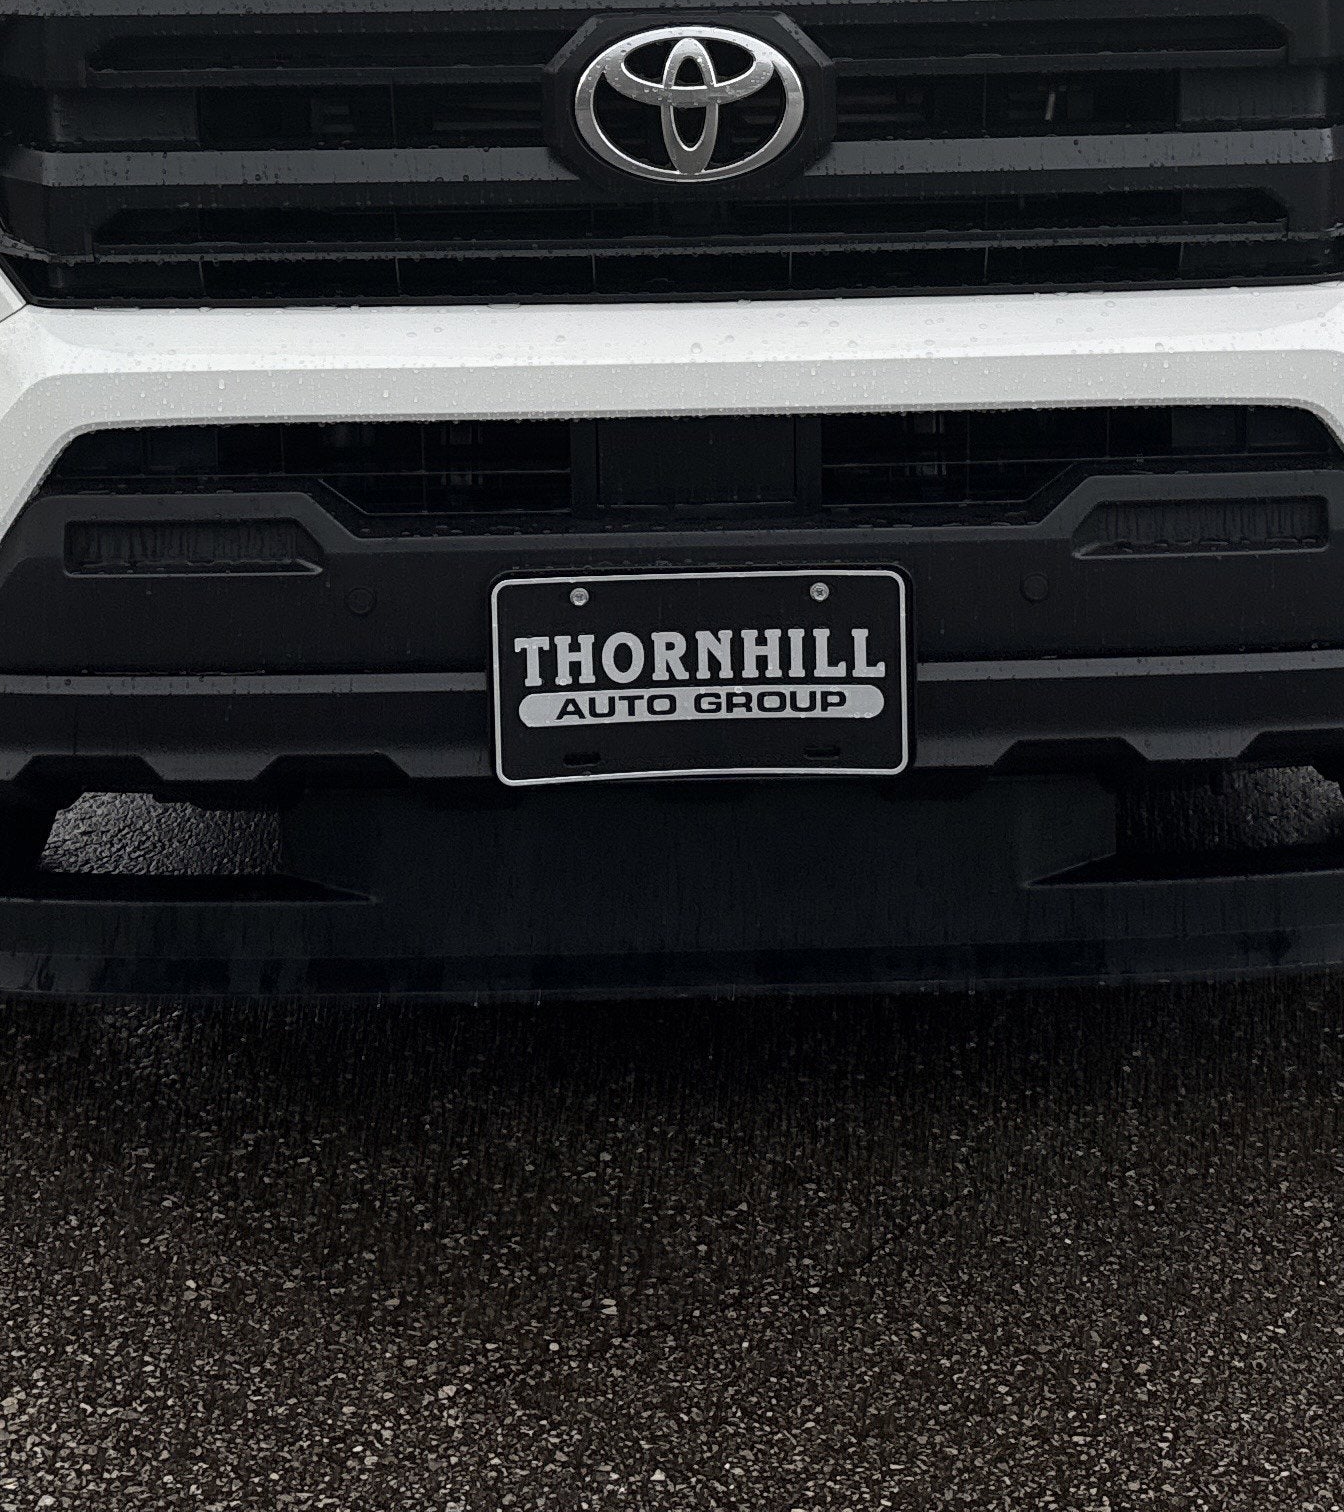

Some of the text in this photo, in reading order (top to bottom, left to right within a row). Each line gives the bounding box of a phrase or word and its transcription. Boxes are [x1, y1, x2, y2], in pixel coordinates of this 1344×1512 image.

[514, 628, 886, 687] THORNHILL
[555, 690, 847, 721] AUTO GROUP
